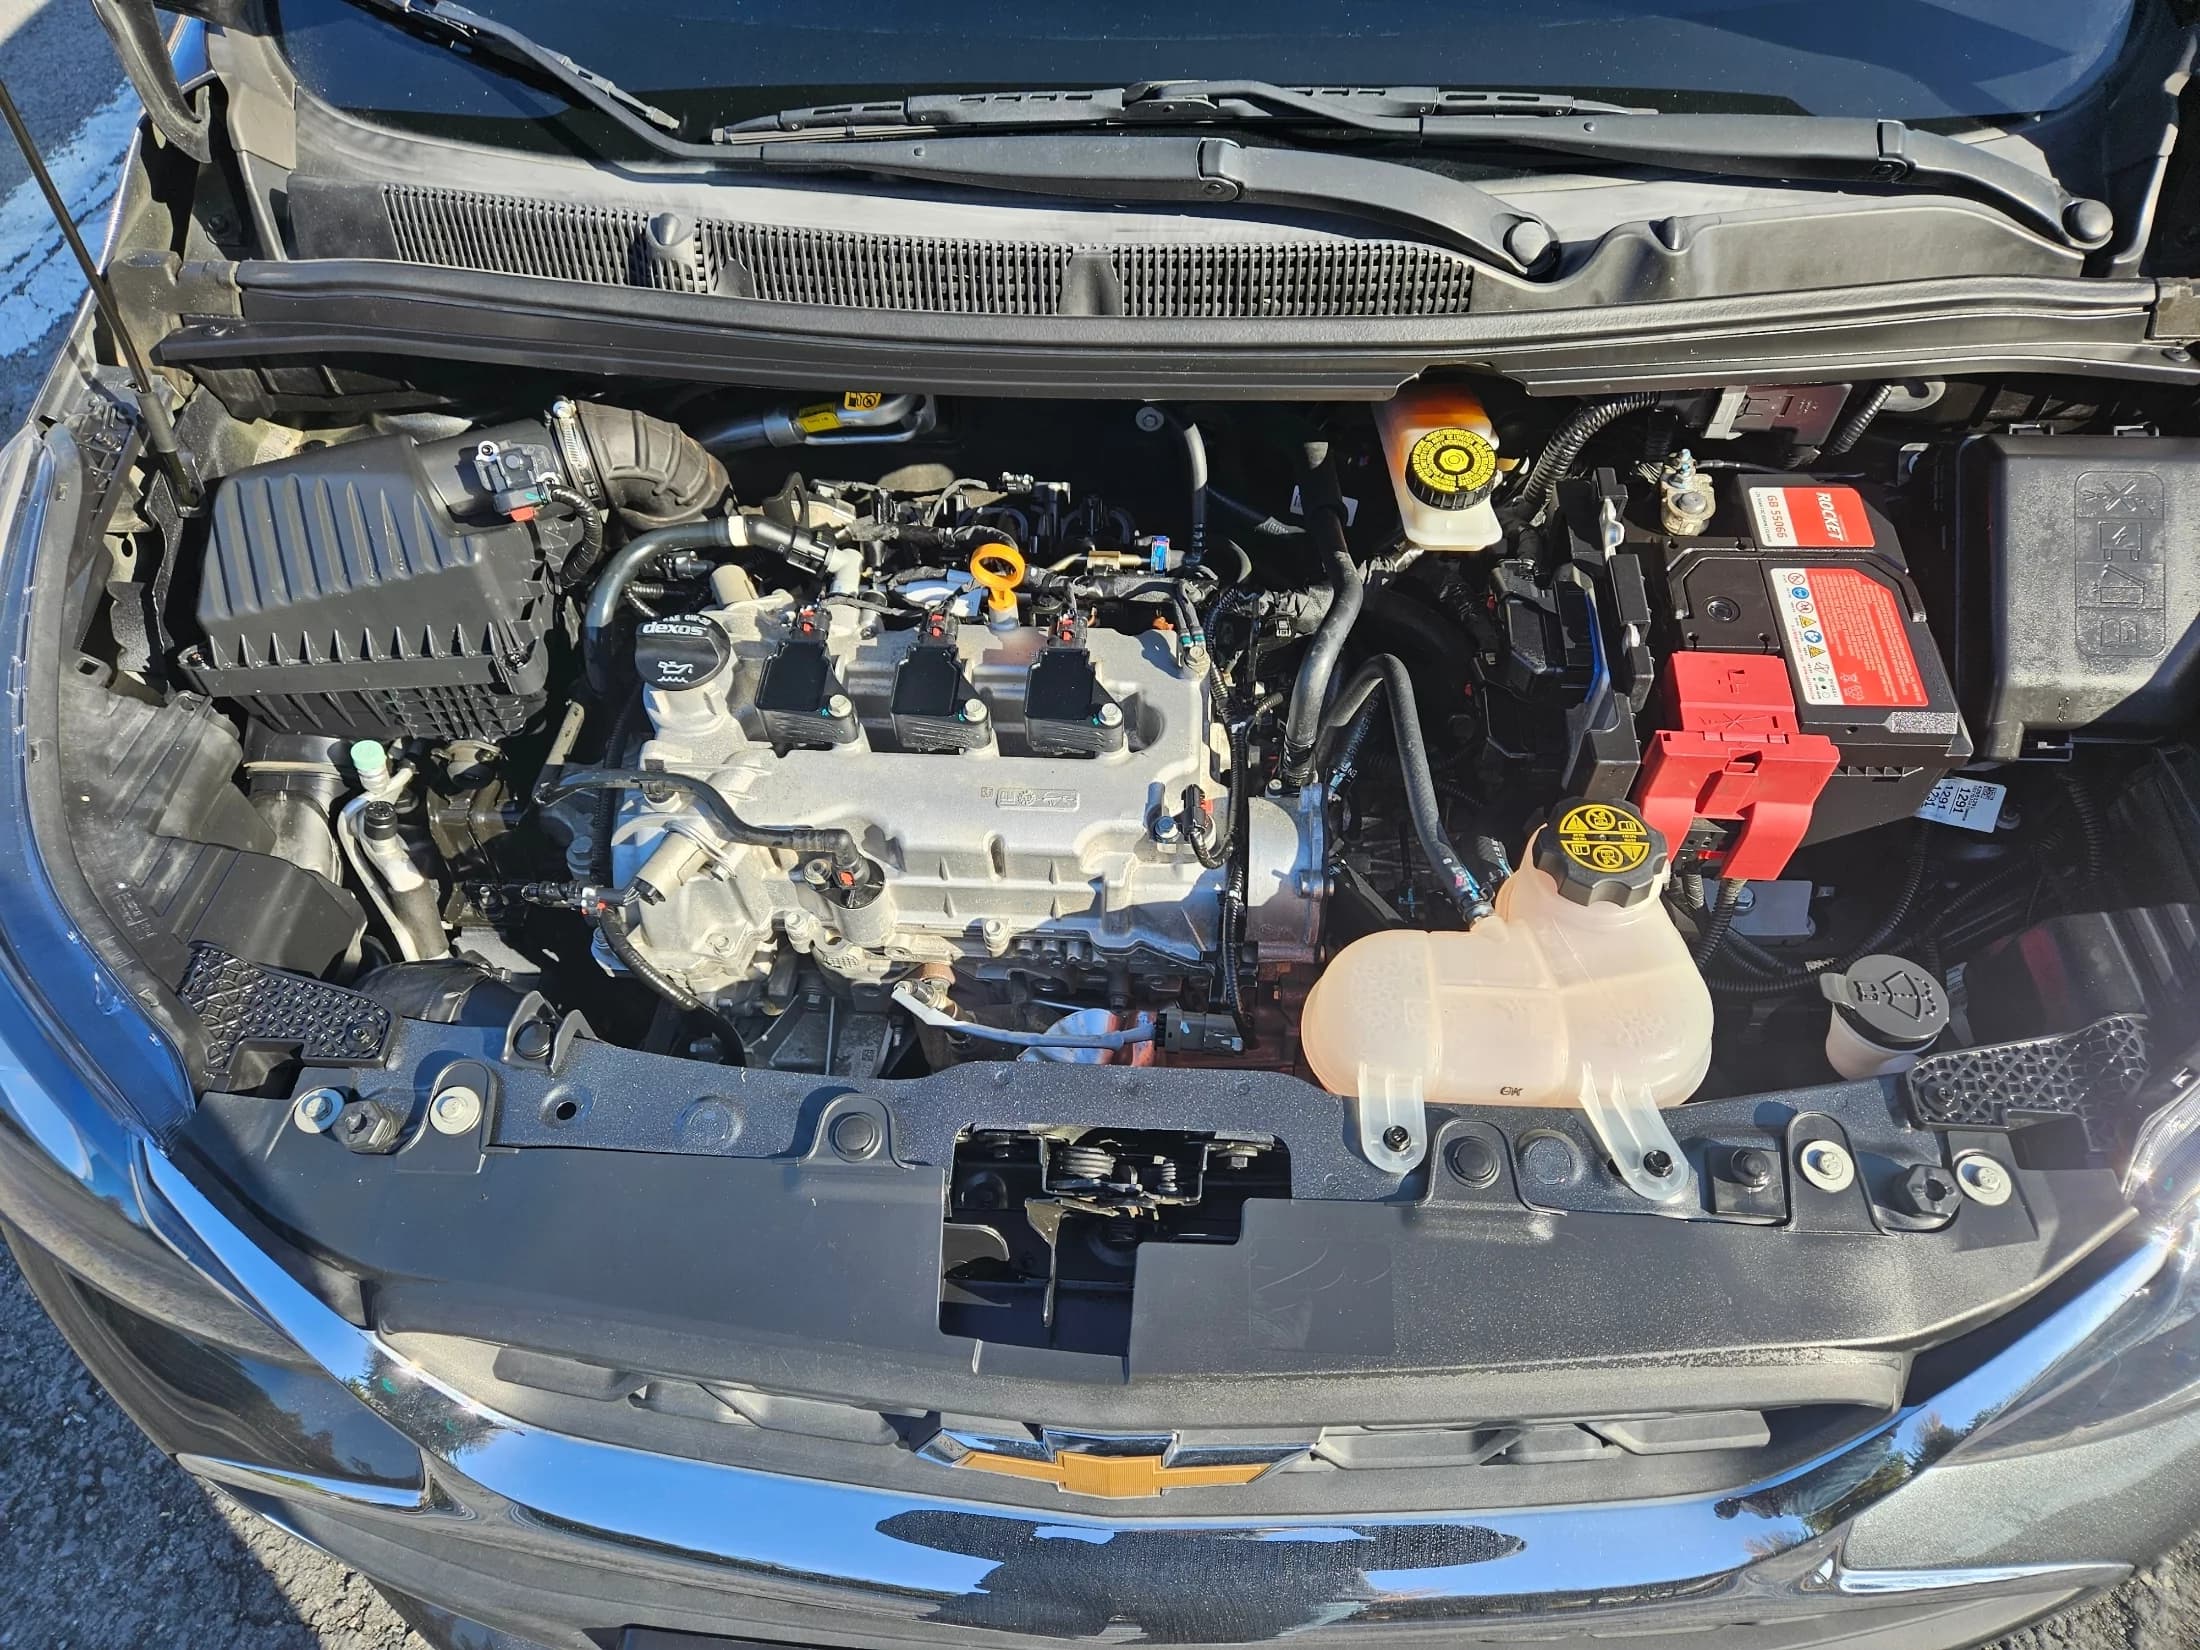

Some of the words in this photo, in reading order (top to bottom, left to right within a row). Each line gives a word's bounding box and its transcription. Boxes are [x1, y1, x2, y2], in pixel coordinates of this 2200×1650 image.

[1767, 495, 1780, 508] GB
[1770, 510, 1788, 539] 55066
[1815, 491, 1844, 541] ROCKET
[642, 621, 708, 636] dexos
[1937, 785, 1954, 810] 1291
[1952, 787, 1971, 813] 1291
